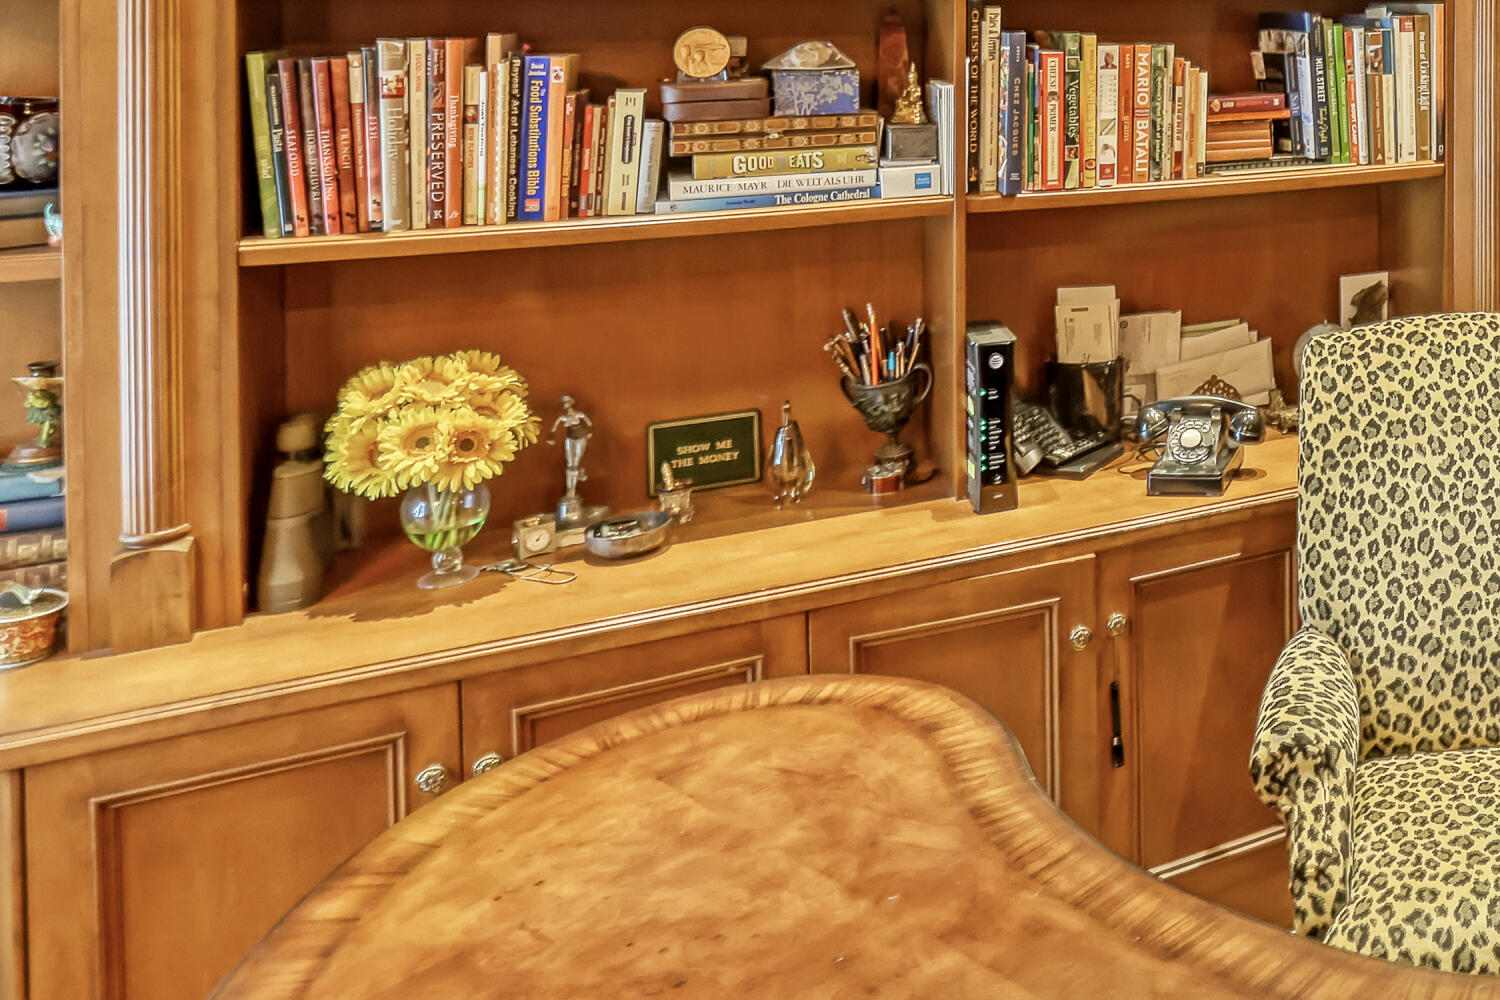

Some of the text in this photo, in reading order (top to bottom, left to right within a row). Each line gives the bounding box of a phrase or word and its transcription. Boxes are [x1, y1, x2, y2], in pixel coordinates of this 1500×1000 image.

[969, 10, 980, 153] CHEESES THE WORLD
[1049, 59, 1057, 133] CHEESE PRIMER
[1314, 57, 1326, 102] MILK STREET
[386, 106, 404, 159] Holiday
[447, 93, 460, 148] Thanksgiving
[1012, 77, 1021, 156] CHEZ JACQUES
[1066, 79, 1080, 139] Vegetables
[1135, 52, 1150, 172] MARIO BATALI
[271, 127, 285, 153] Pasta
[286, 129, 300, 177] SEAFOOD
[430, 112, 446, 203] PRESERVED
[509, 129, 519, 175] Lebanese
[526, 79, 544, 196] Food Substitutions Bible
[732, 151, 824, 174] GOOD EATS
[320, 128, 334, 202] THANKSGIVING
[683, 173, 865, 195] MAURICE MAYR DIE WELT UHR
[774, 187, 870, 205] The Cologne Cathedral
[671, 450, 740, 469] THE MONEY
[676, 439, 734, 457] SHOW ME
